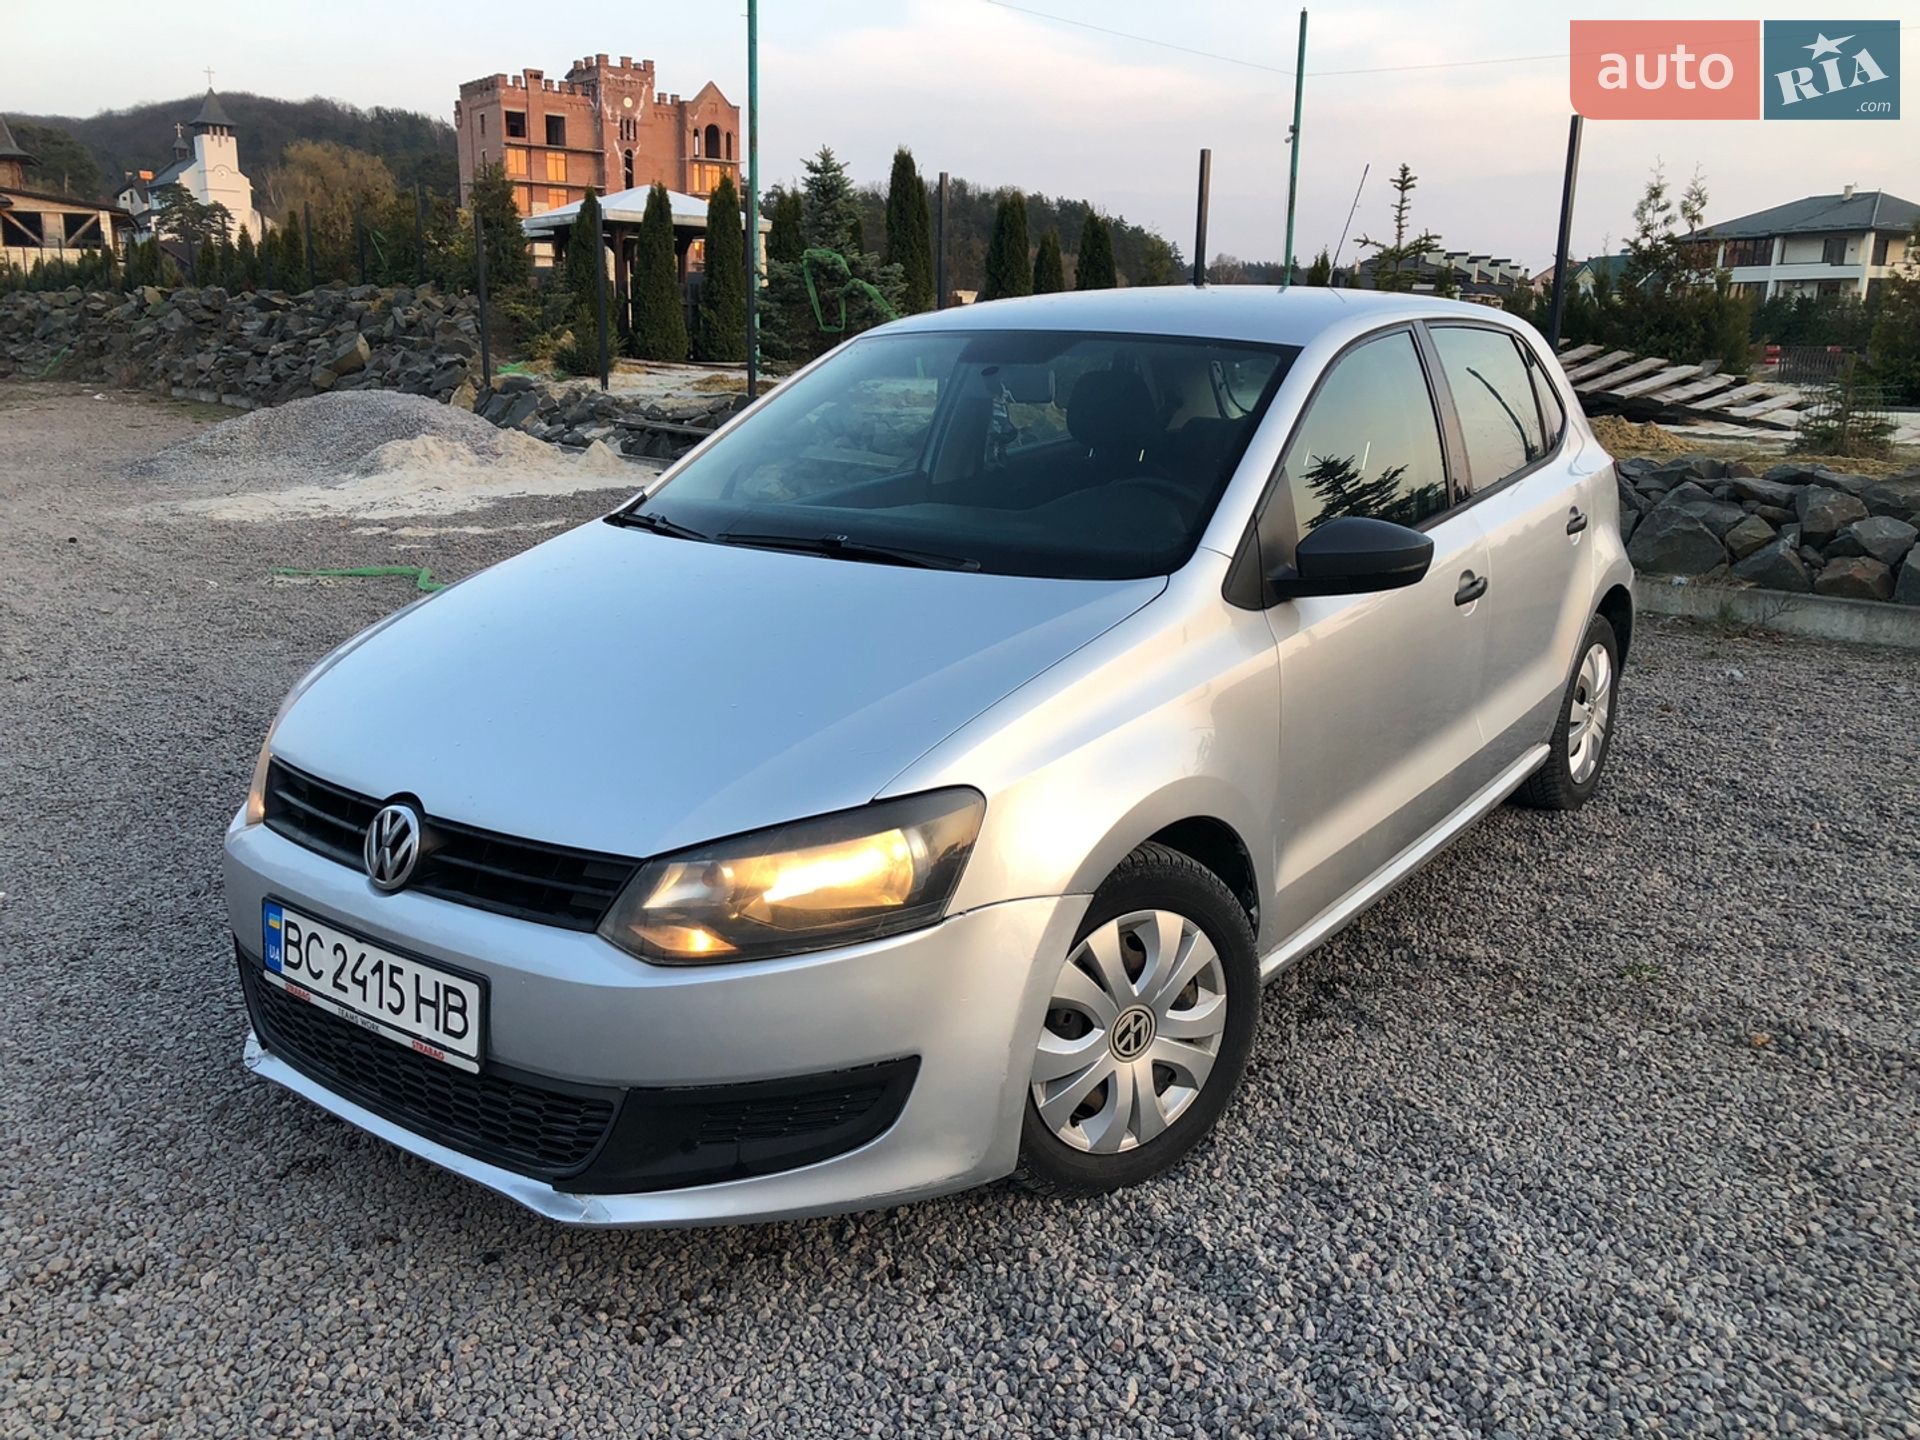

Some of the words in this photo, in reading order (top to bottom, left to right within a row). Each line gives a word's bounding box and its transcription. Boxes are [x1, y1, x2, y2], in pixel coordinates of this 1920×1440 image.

[269, 944, 280, 962] UA
[284, 919, 324, 980] BC
[332, 943, 405, 1015] 2415
[415, 973, 469, 1040] HB
[412, 1039, 444, 1060] STRABAG
